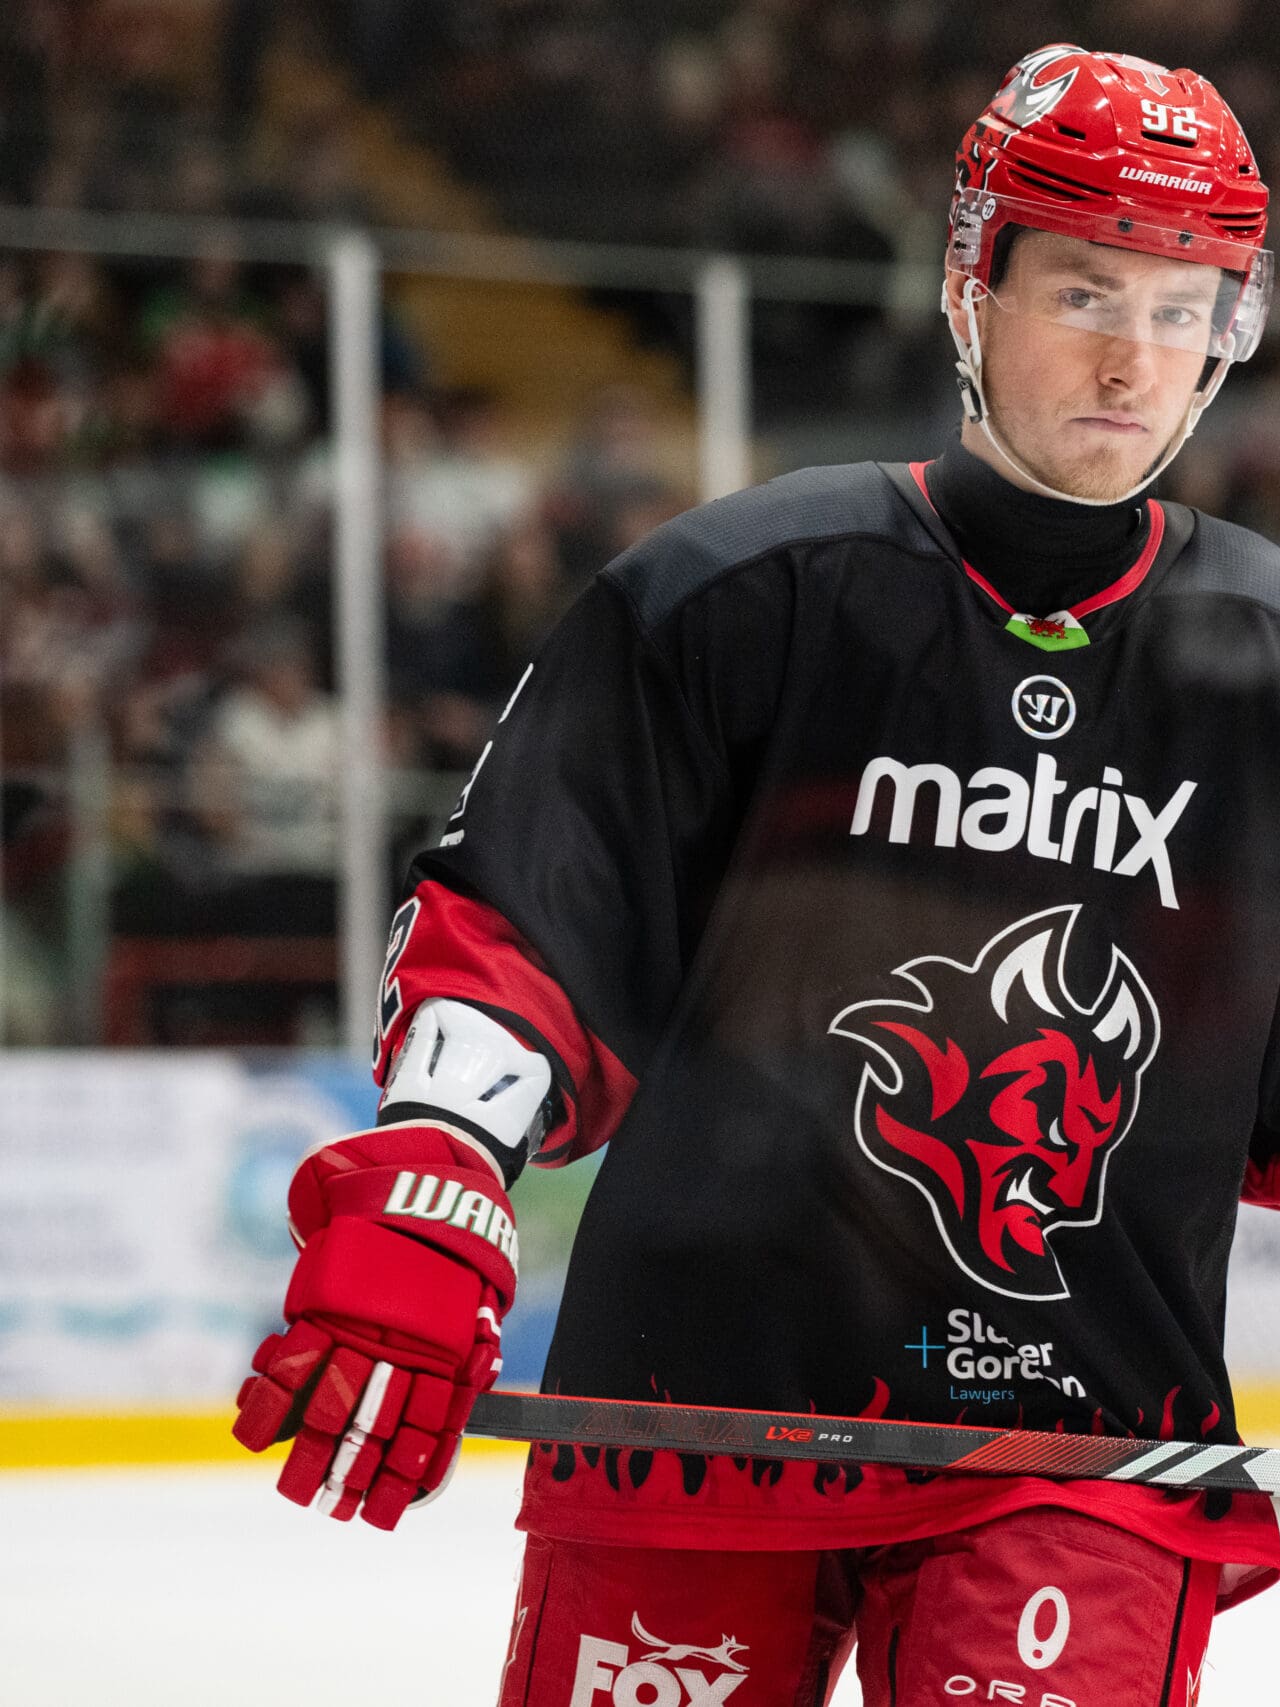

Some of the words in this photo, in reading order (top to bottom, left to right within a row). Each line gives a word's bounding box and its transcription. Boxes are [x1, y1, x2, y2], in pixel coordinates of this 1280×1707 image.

[1140, 99, 1198, 140] 92
[1119, 166, 1213, 195] WARRIOR
[850, 752, 1198, 910] matrix
[383, 1170, 519, 1282] WAR
[950, 1385, 1015, 1405] Lawyers
[818, 1433, 853, 1443] PRO
[569, 1633, 749, 1707] FOX
